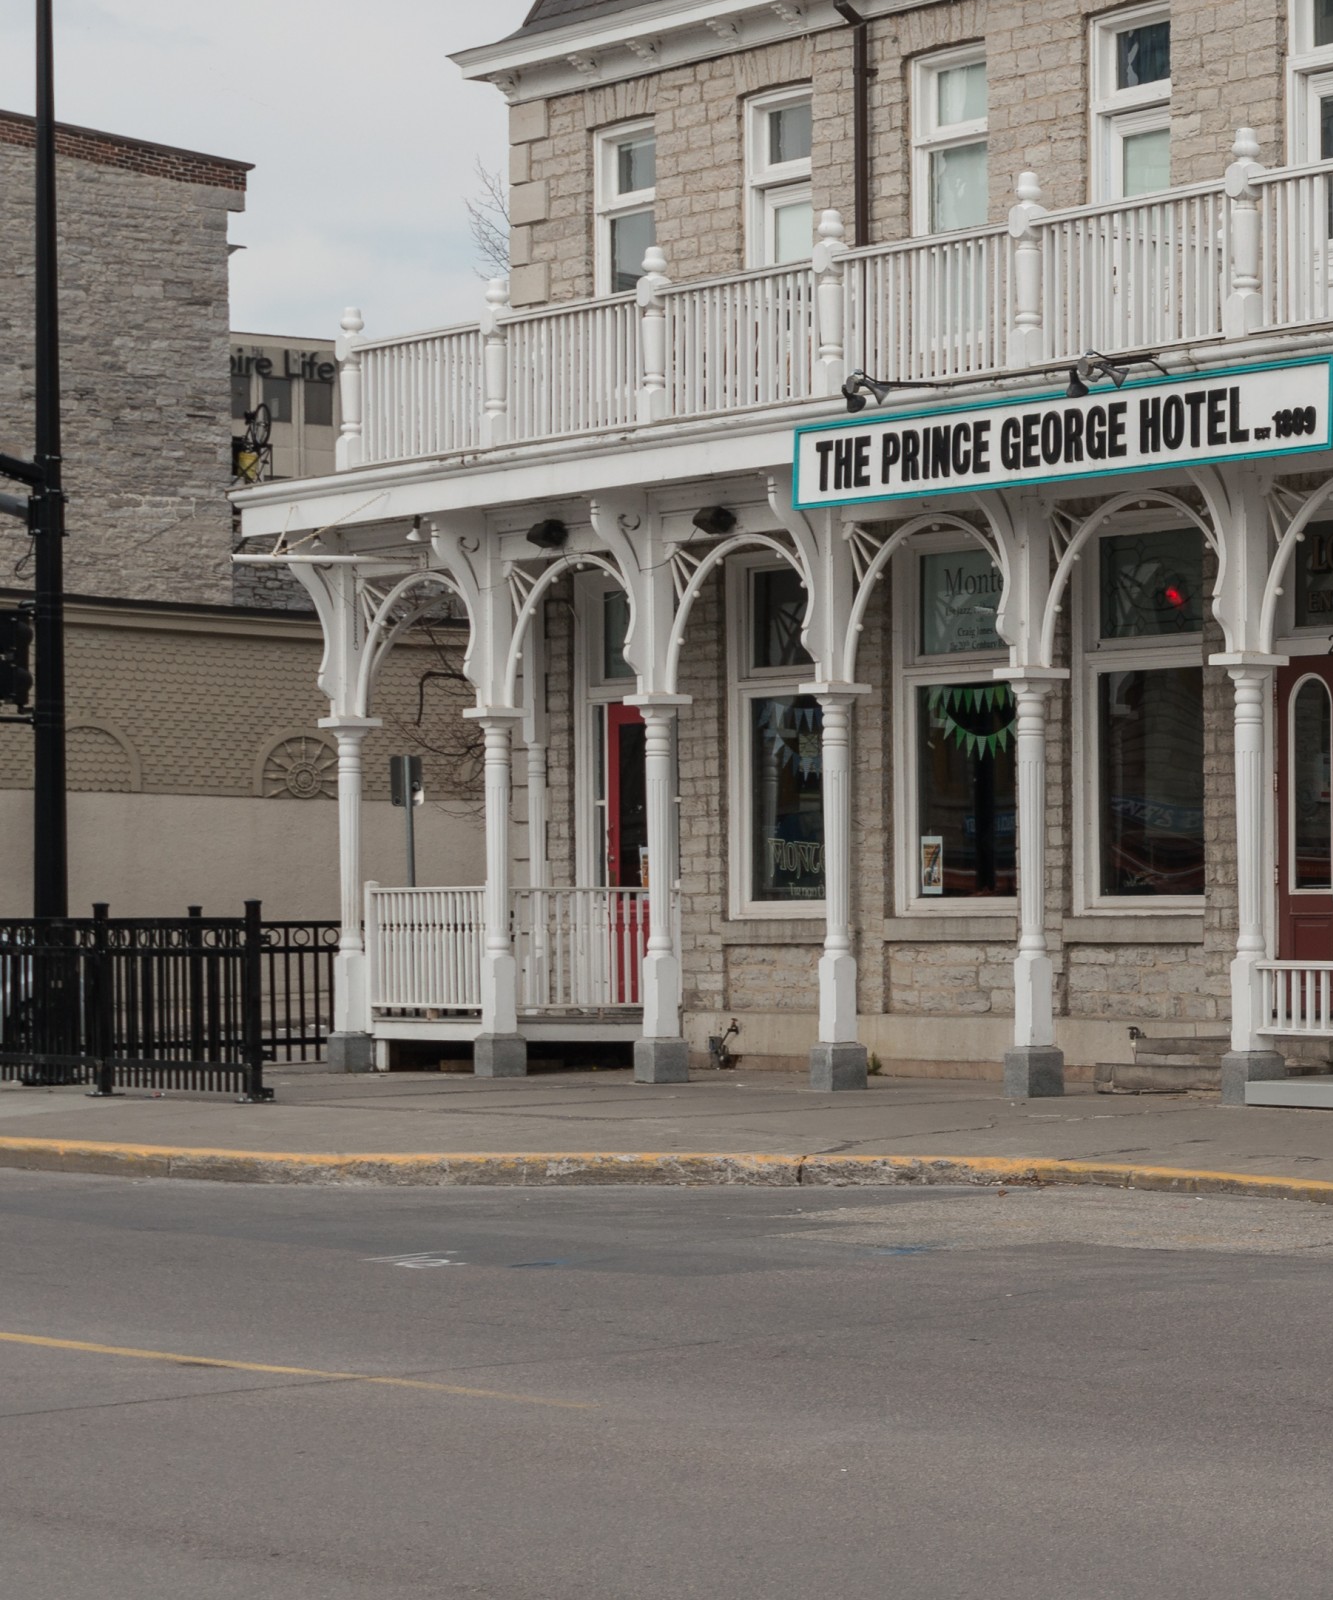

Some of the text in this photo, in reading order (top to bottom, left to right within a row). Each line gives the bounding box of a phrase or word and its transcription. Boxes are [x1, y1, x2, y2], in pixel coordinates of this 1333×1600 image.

[284, 349, 335, 381] Life
[816, 435, 871, 492] THE
[881, 419, 991, 485] PRINCE
[1000, 400, 1128, 472] GEORGE
[1139, 386, 1249, 454] HOTEL
